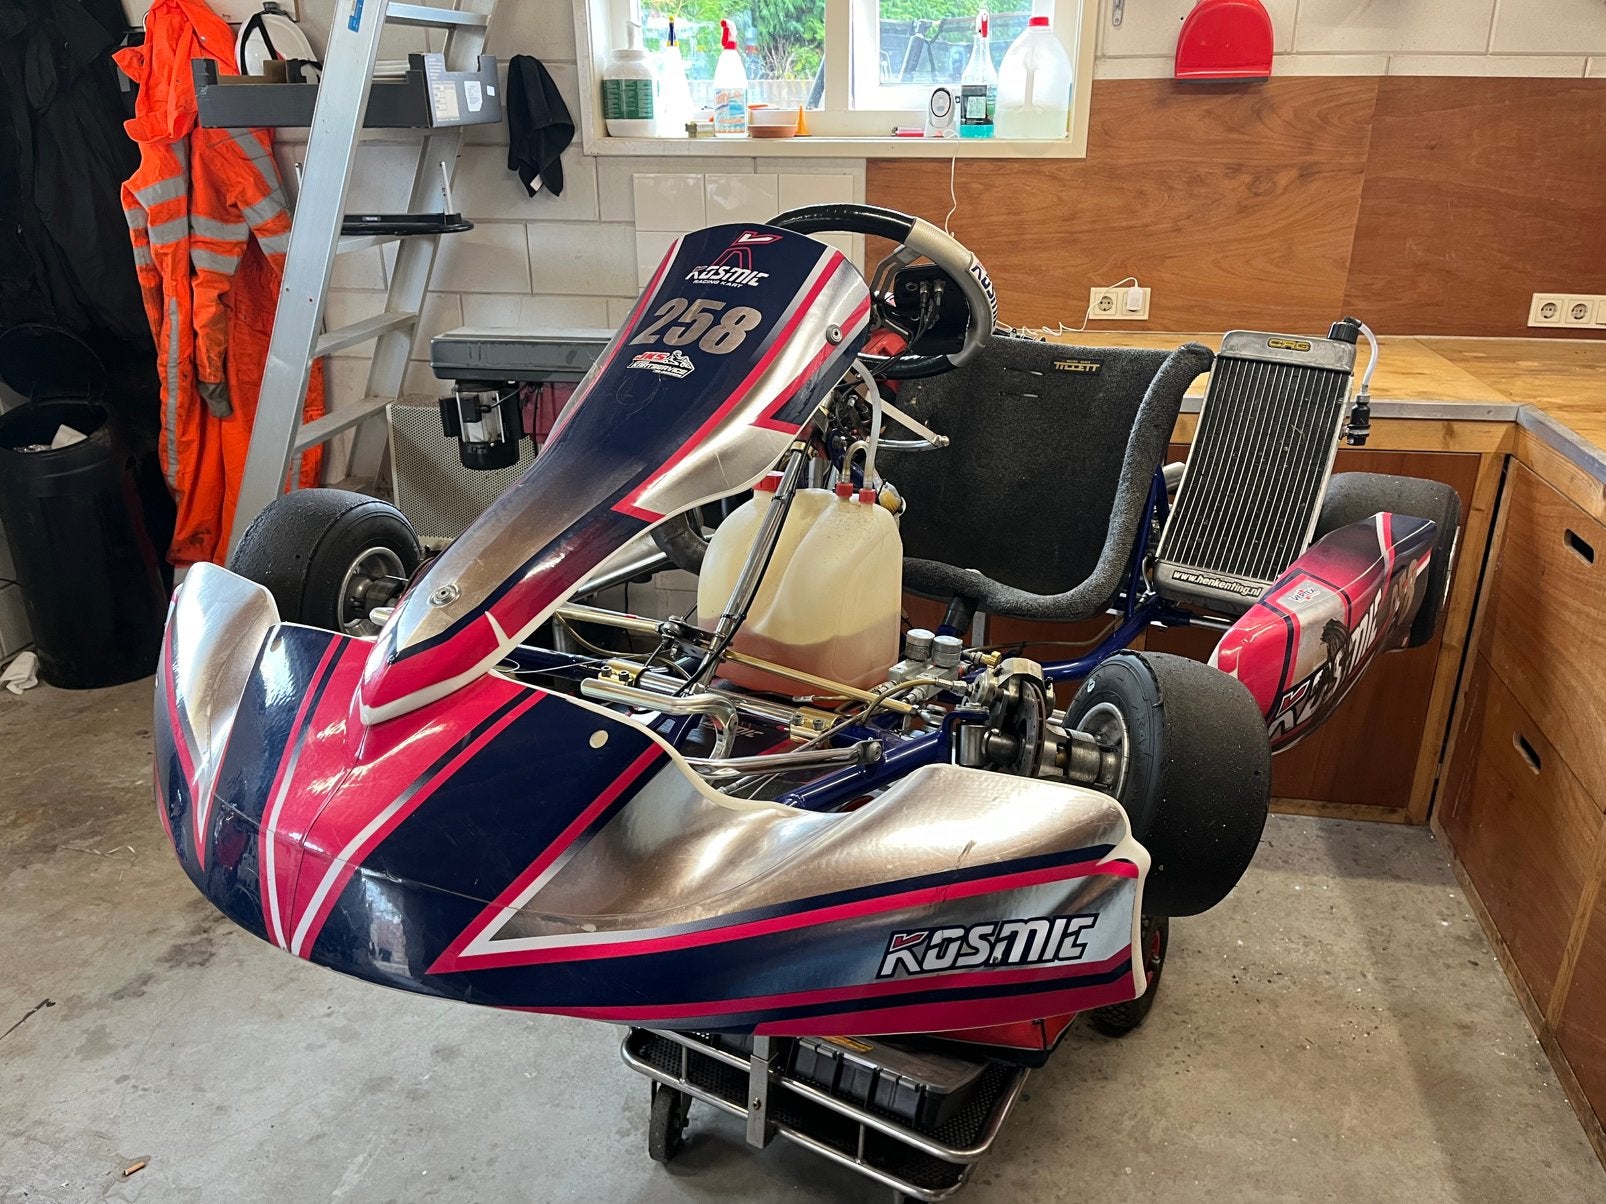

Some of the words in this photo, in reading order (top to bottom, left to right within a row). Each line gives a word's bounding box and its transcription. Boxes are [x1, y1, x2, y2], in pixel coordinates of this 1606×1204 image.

[684, 265, 770, 288] KOSMIC
[628, 297, 763, 355] 258
[1172, 570, 1263, 597] www.henkenting.nl
[876, 914, 1099, 979] KOSMIC
